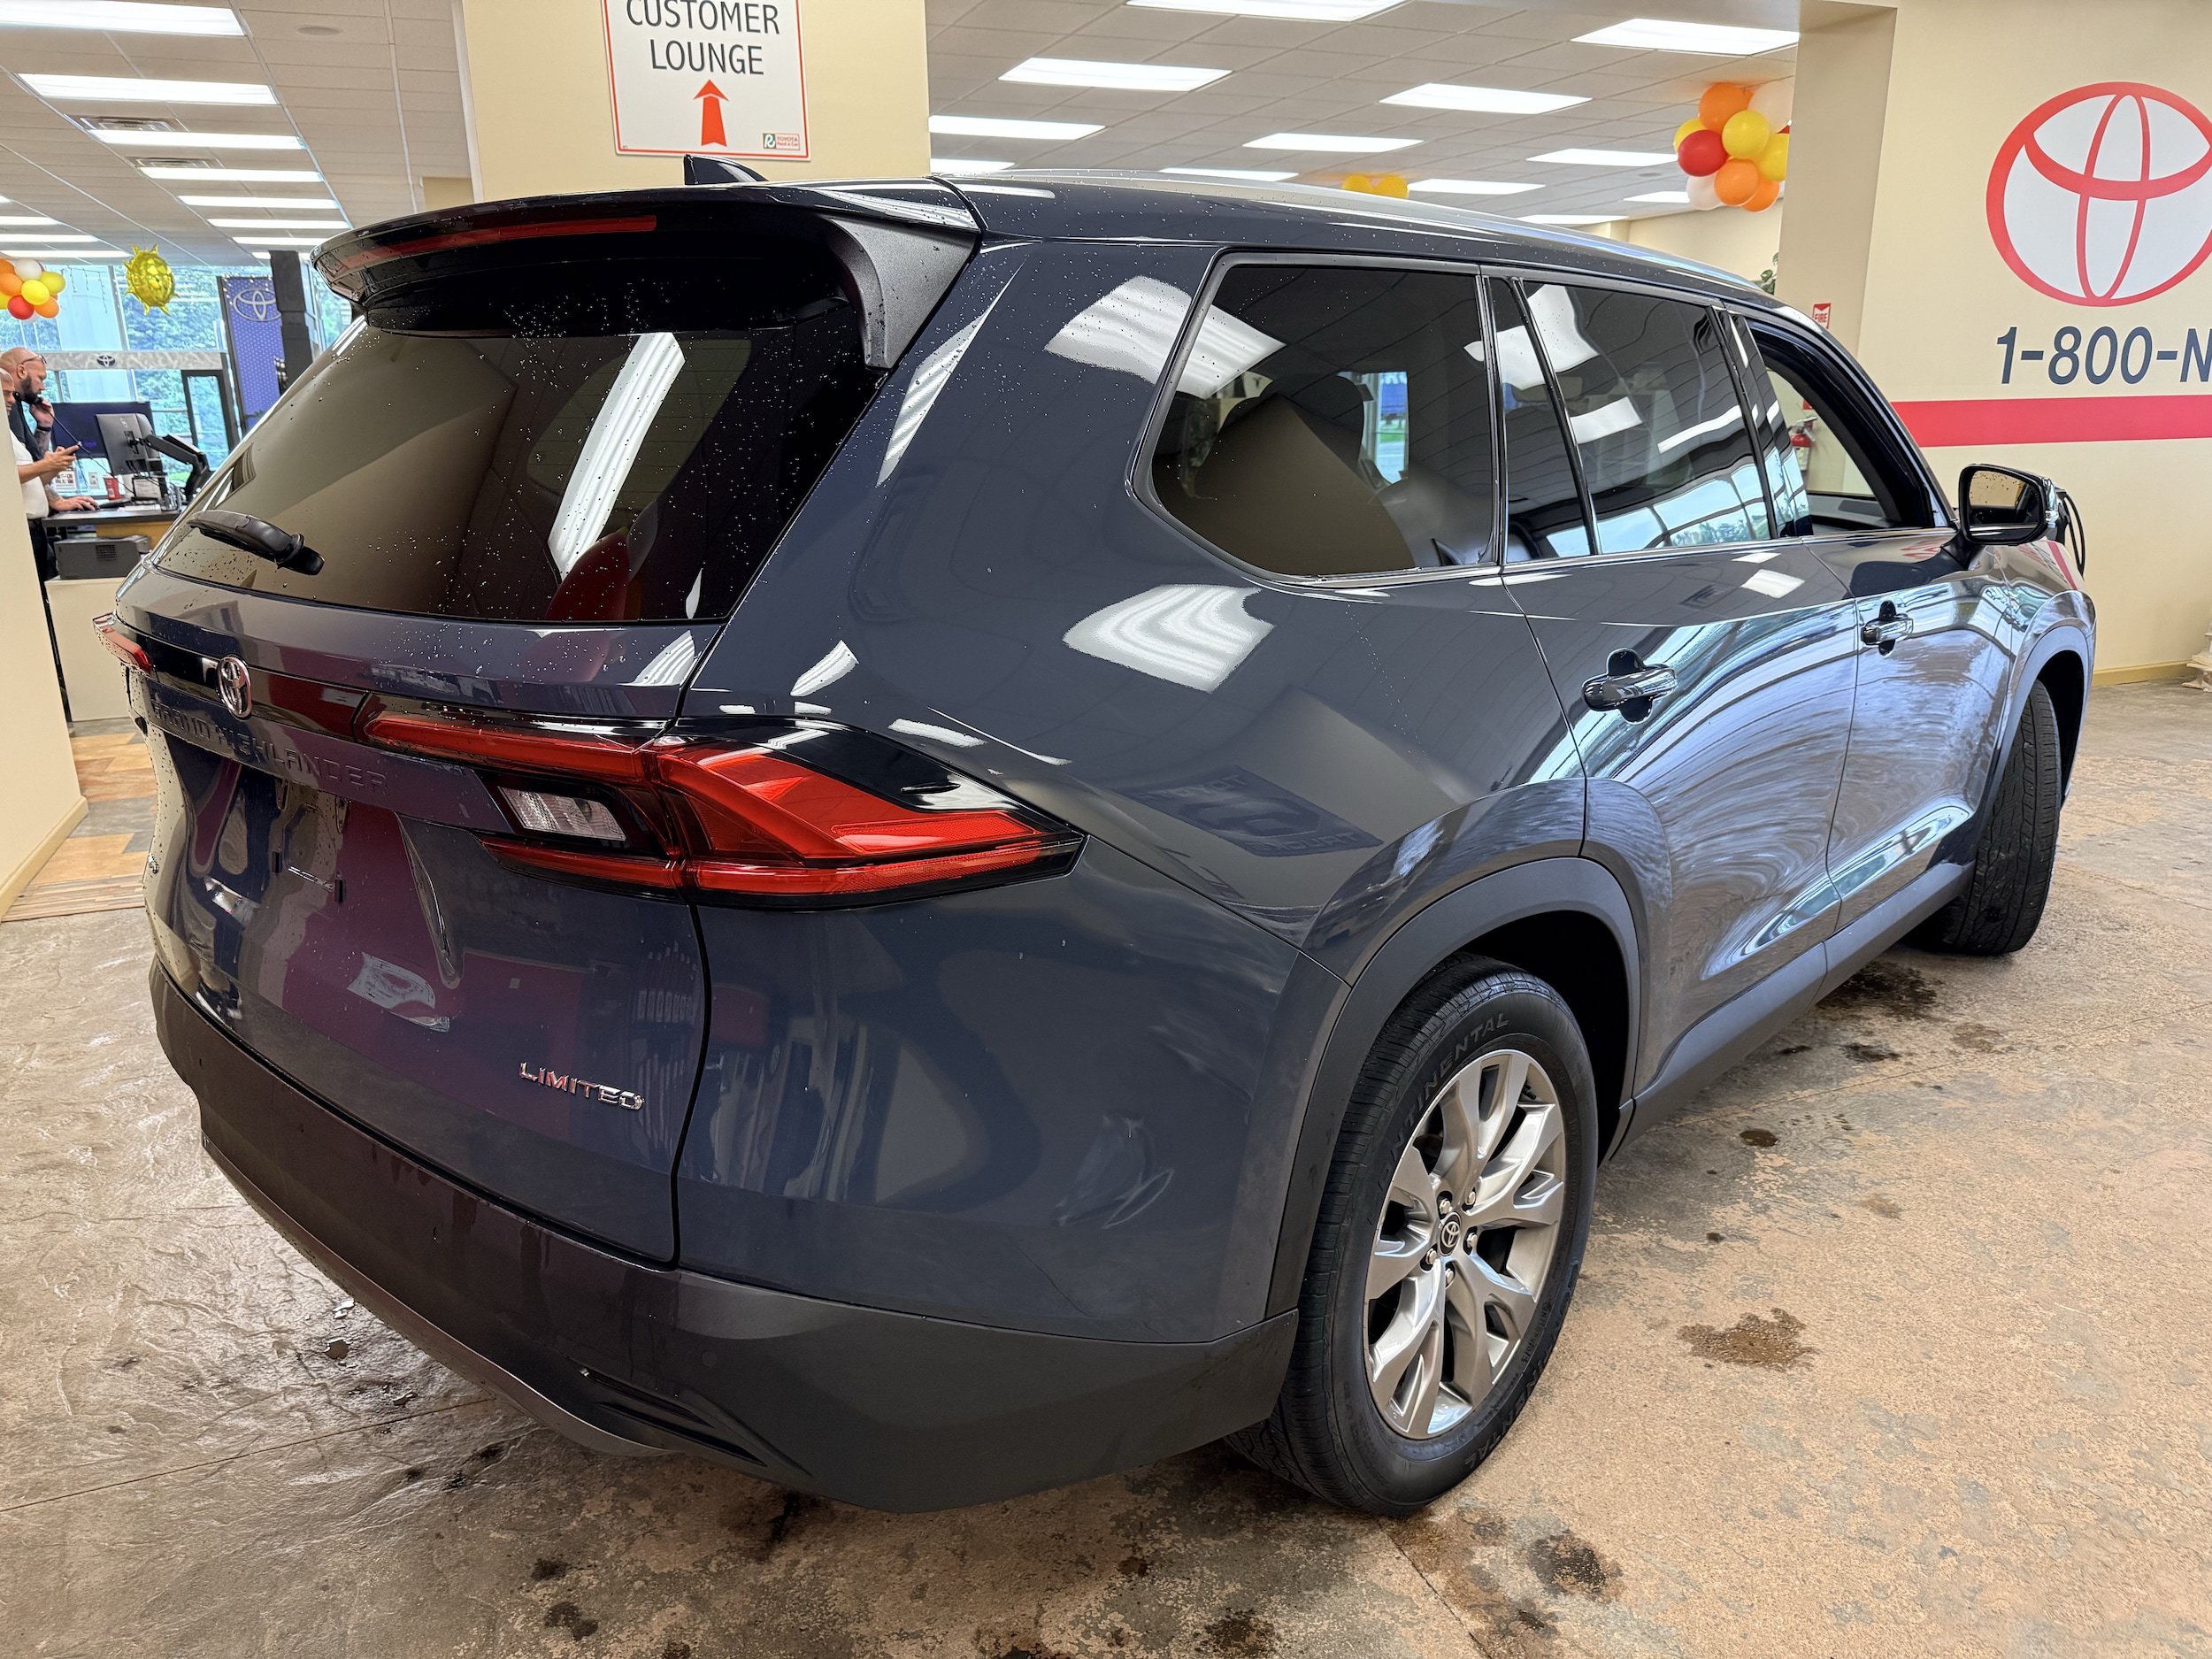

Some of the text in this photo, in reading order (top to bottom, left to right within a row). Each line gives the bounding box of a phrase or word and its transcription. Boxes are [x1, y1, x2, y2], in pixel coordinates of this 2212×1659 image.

[626, 0, 780, 35] CUSTOMER
[650, 39, 764, 75] LOUNGE
[1815, 312, 1828, 323] FIRE
[1997, 326, 2212, 385] 1-800-N
[518, 1062, 644, 1110] LIMITED
